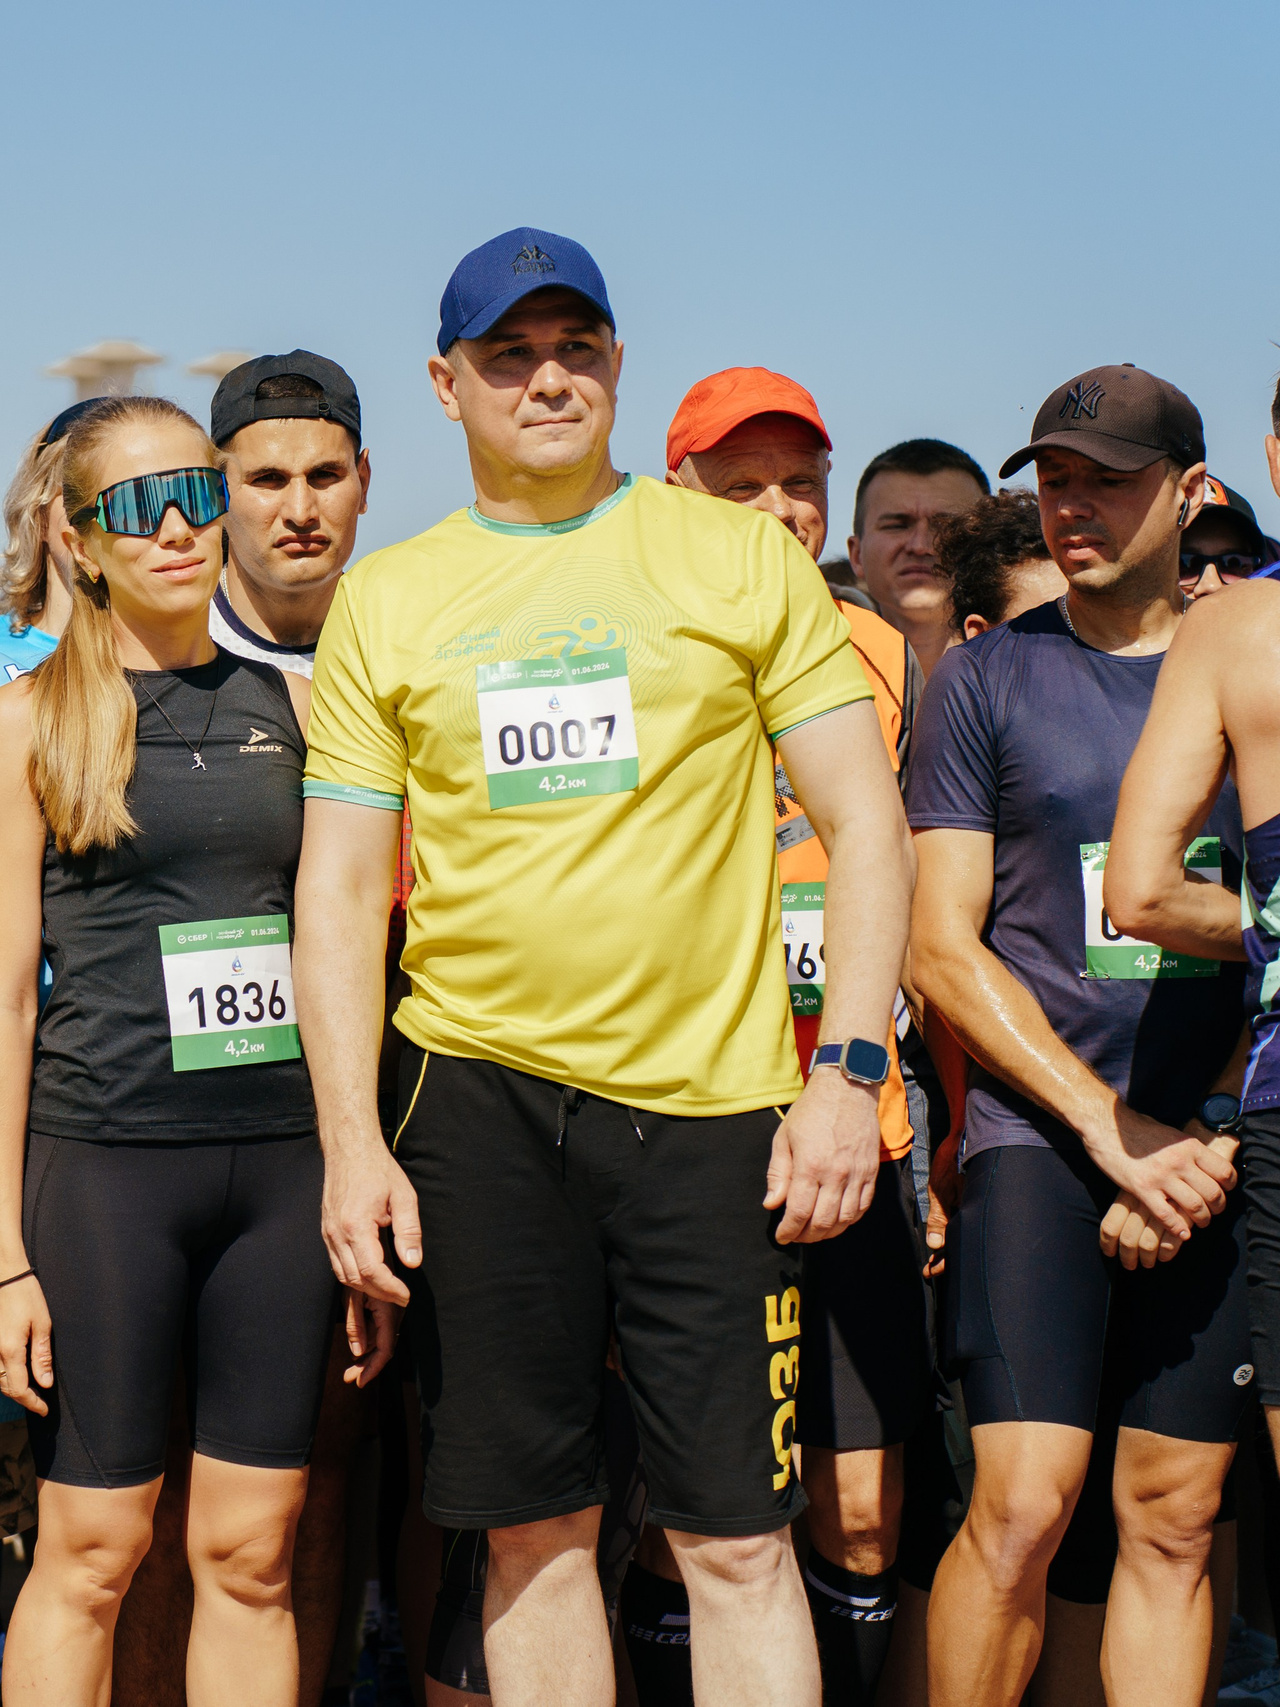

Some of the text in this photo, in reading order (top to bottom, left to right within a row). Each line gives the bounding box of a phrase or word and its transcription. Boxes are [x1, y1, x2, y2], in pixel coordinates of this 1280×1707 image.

[512, 261, 556, 275] Kappa
[431, 643, 495, 661] арафон
[571, 662, 610, 676] 01.06.2024
[498, 714, 616, 766] 0007
[239, 745, 283, 753] DEMIX
[187, 933, 208, 942] СБЕР
[251, 927, 280, 936] 01.06.2024
[188, 979, 287, 1028] 1836
